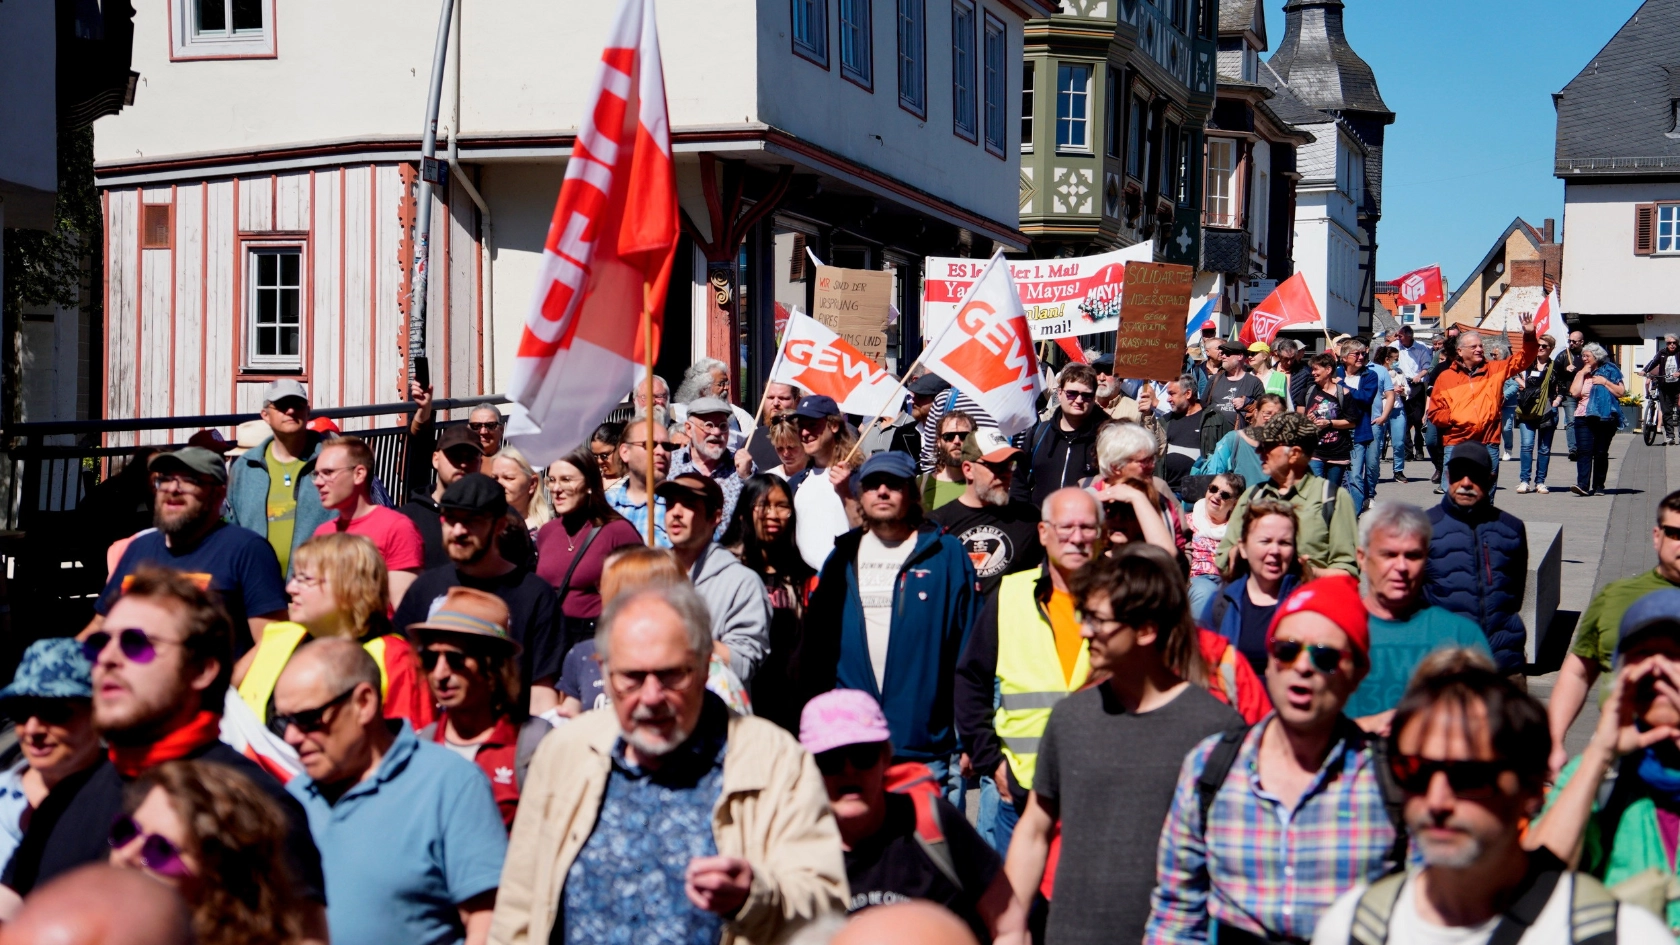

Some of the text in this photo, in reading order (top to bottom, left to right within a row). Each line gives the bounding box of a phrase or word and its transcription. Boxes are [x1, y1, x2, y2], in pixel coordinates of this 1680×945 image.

[947, 263, 967, 278] ES
[1034, 265, 1044, 279] 1.
[1048, 263, 1079, 278] Mai!
[819, 277, 867, 292] WIR SIND DER
[1027, 282, 1080, 302] Mayıs!
[819, 297, 859, 311] URSPRUNG
[1125, 293, 1187, 306] WIDERSTAND
[1143, 313, 1169, 321] GEGEN
[1040, 320, 1072, 335] mai!
[863, 336, 882, 347] UND
[957, 300, 1034, 391] GEW
[784, 339, 889, 385] GEW
[1119, 354, 1148, 366] KRIEG
